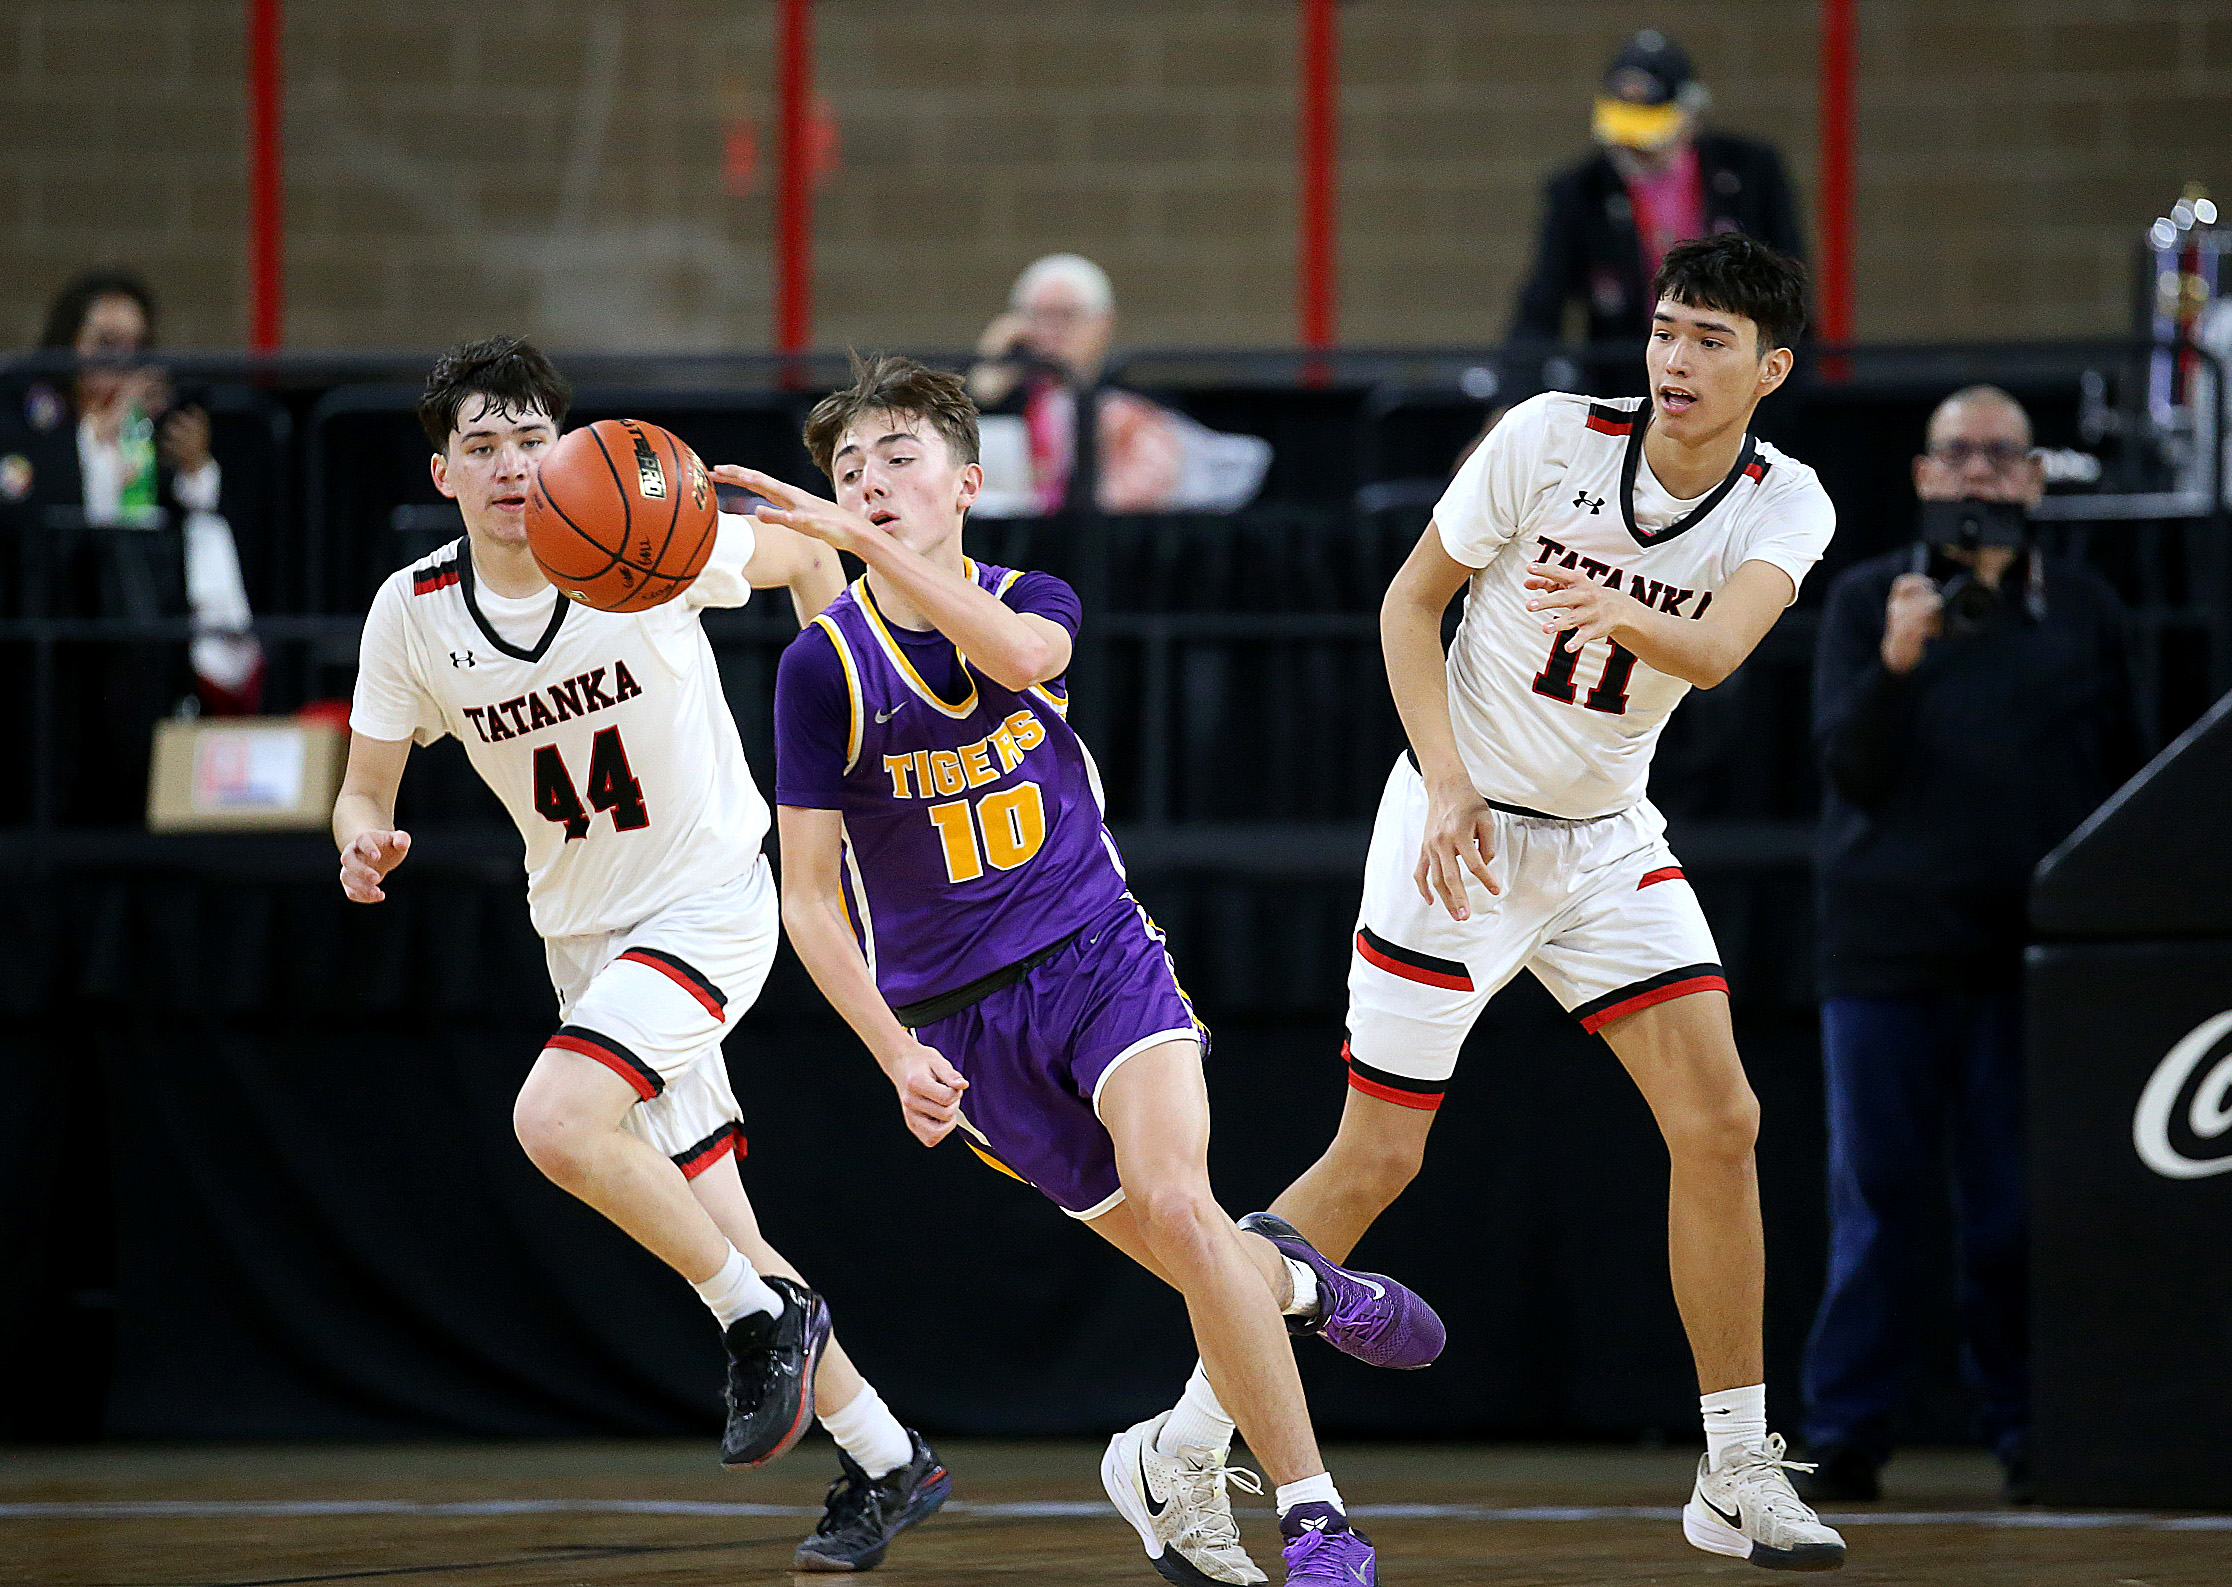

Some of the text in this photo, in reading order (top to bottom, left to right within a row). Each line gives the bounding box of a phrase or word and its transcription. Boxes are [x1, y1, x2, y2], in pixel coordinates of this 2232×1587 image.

[462, 659, 643, 743] TATANKA
[1532, 616, 1638, 715] 11
[533, 724, 650, 843] 44
[883, 709, 1046, 799] TIGERS
[927, 780, 1046, 884] 10
